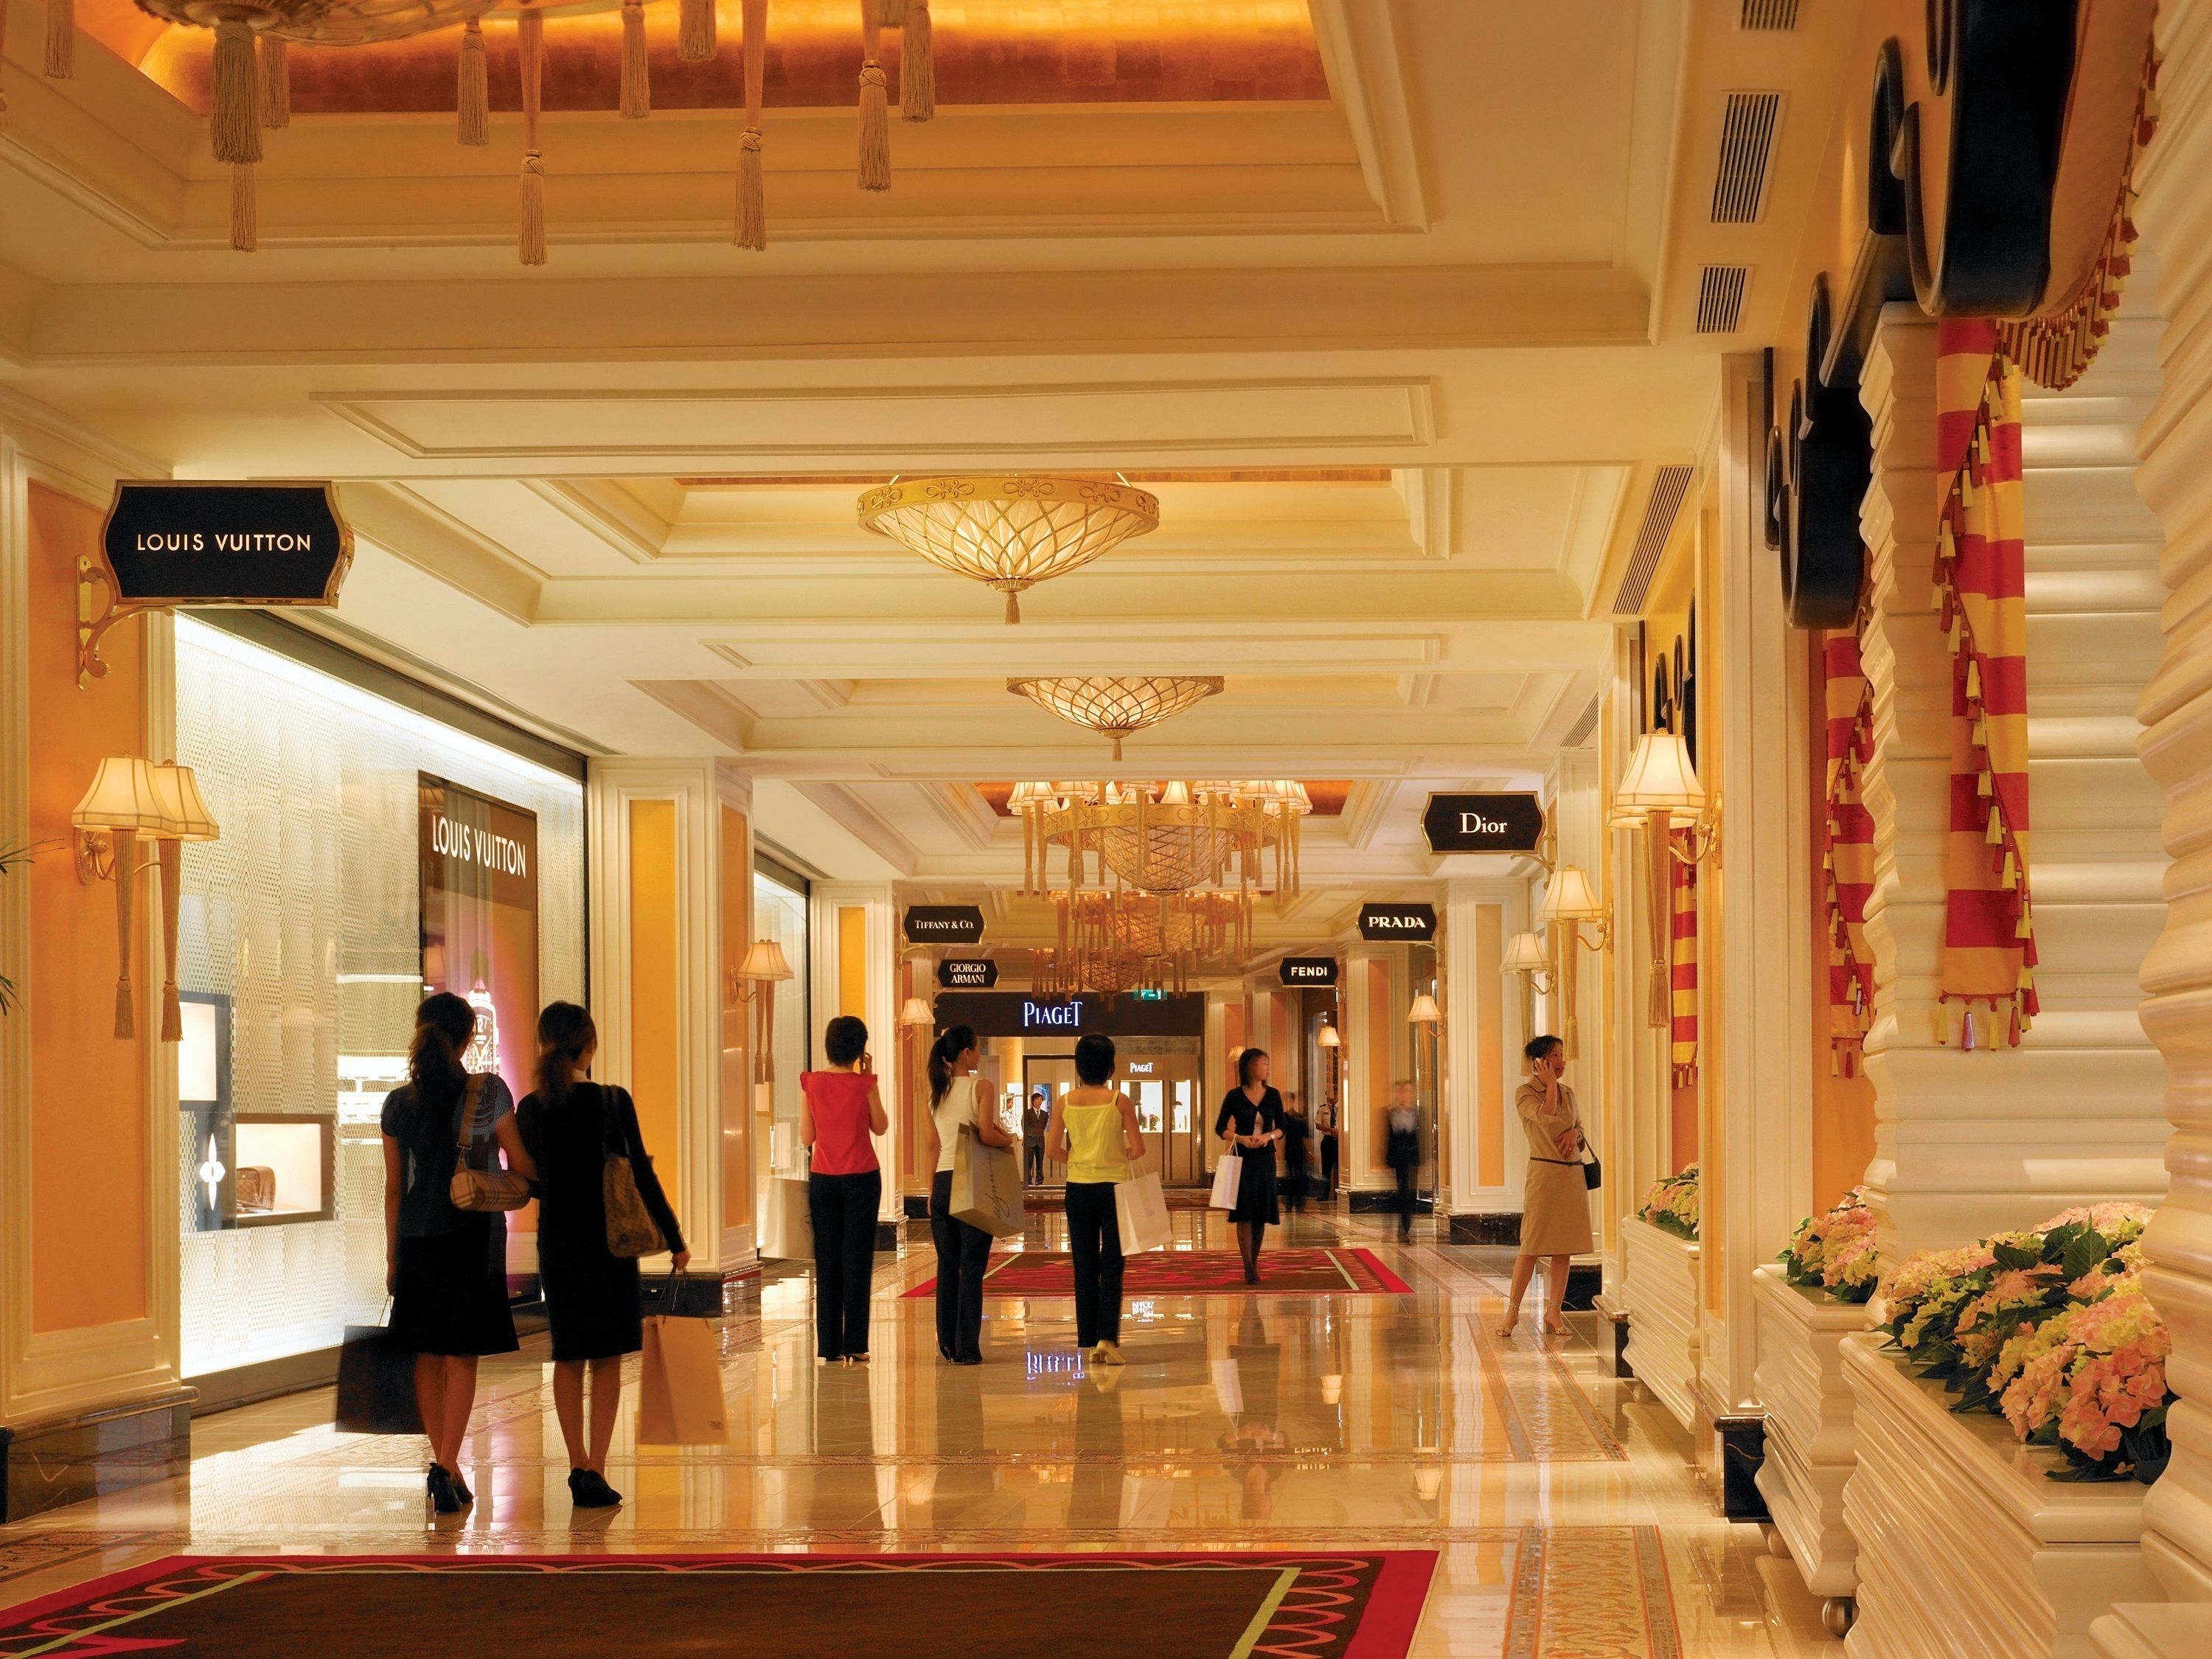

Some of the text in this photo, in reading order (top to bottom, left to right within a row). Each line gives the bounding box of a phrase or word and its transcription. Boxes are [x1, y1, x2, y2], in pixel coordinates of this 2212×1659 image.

[137, 533, 310, 552] LOUIS VUITTON
[1458, 813, 1508, 833] Dior
[432, 813, 526, 879] LOUIS VUITTON
[914, 919, 950, 929] TIFFANY
[951, 920, 959, 929] &
[1368, 917, 1426, 928] PRADA
[949, 963, 987, 973] GIORGIO
[1291, 967, 1327, 976] FENDI
[950, 974, 984, 984] ARMANI
[1023, 1001, 1083, 1027] PIAGET
[1130, 1062, 1154, 1074] PIAGET
